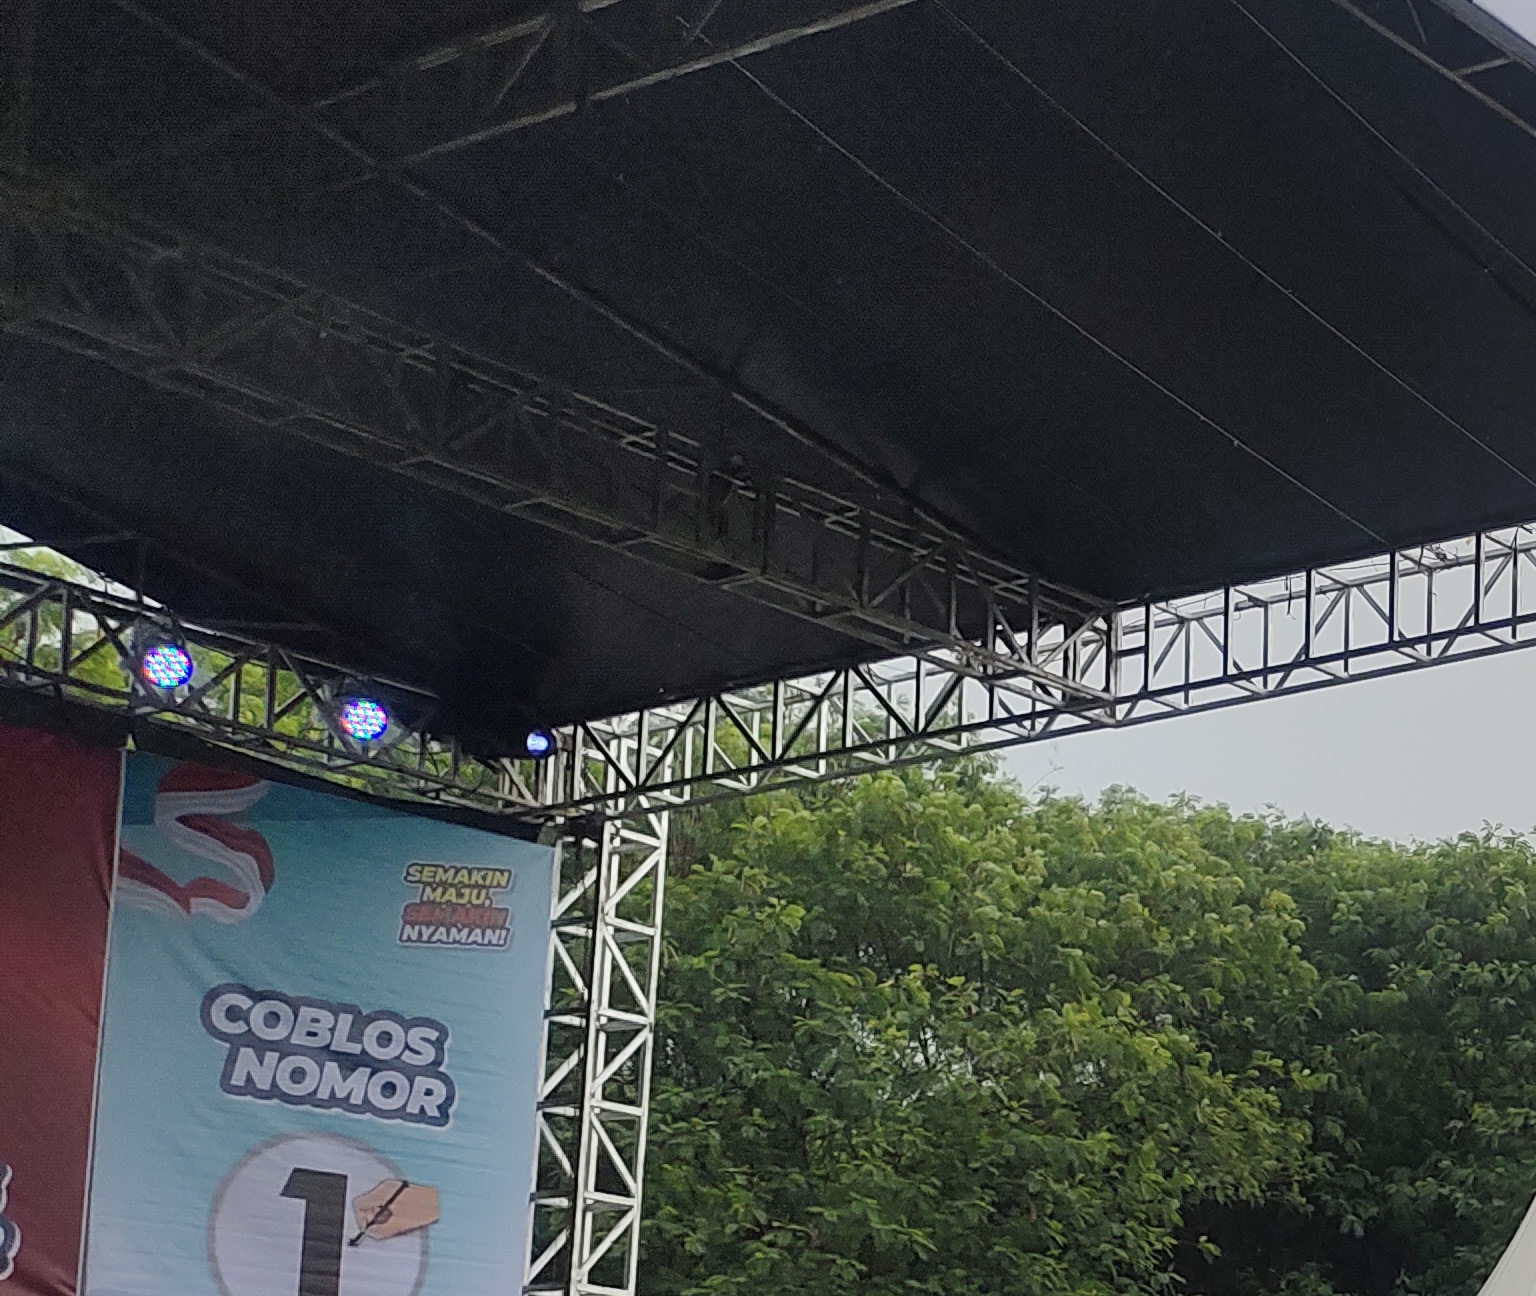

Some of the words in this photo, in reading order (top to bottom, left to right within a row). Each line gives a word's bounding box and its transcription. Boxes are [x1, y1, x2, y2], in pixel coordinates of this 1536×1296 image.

[406, 864, 510, 887] SEMAKIN
[401, 924, 508, 945] NYAMAN!
[208, 992, 439, 1067] COBLOS
[229, 1046, 449, 1118] NOMOR
